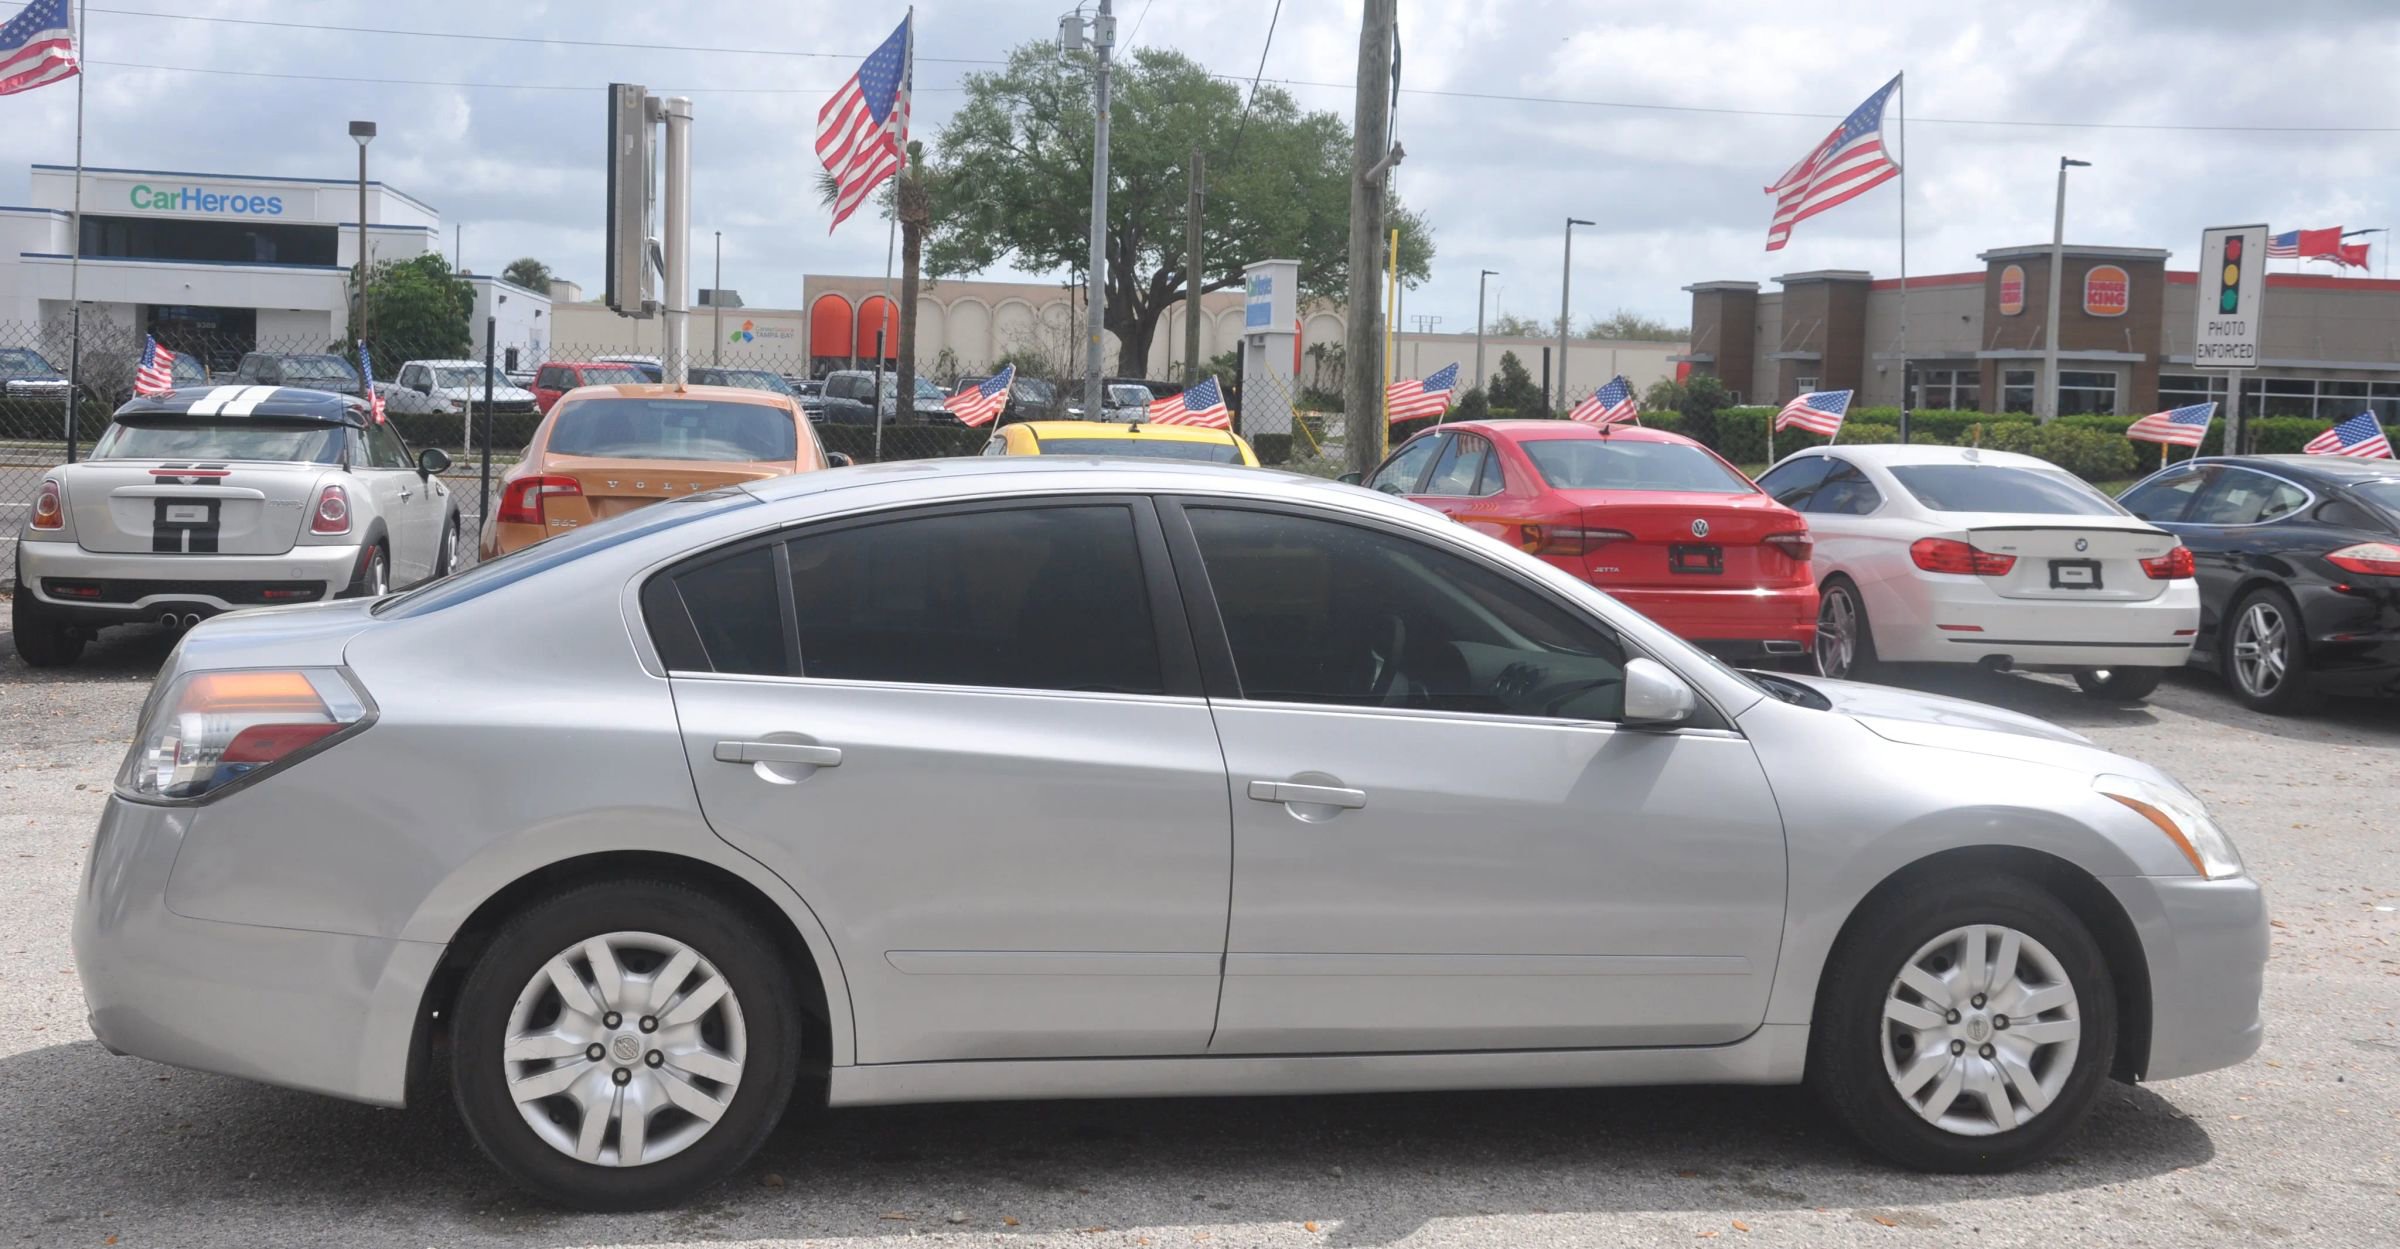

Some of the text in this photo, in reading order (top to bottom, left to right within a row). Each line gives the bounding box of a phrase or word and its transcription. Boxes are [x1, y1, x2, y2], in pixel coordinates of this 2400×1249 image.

[130, 184, 283, 215] CarHeroes
[2087, 292, 2126, 306] KING
[2208, 321, 2245, 336] PHOTO
[780, 332, 795, 340] BAY
[2197, 343, 2254, 359] ENFORCED
[607, 480, 724, 491] VOLV
